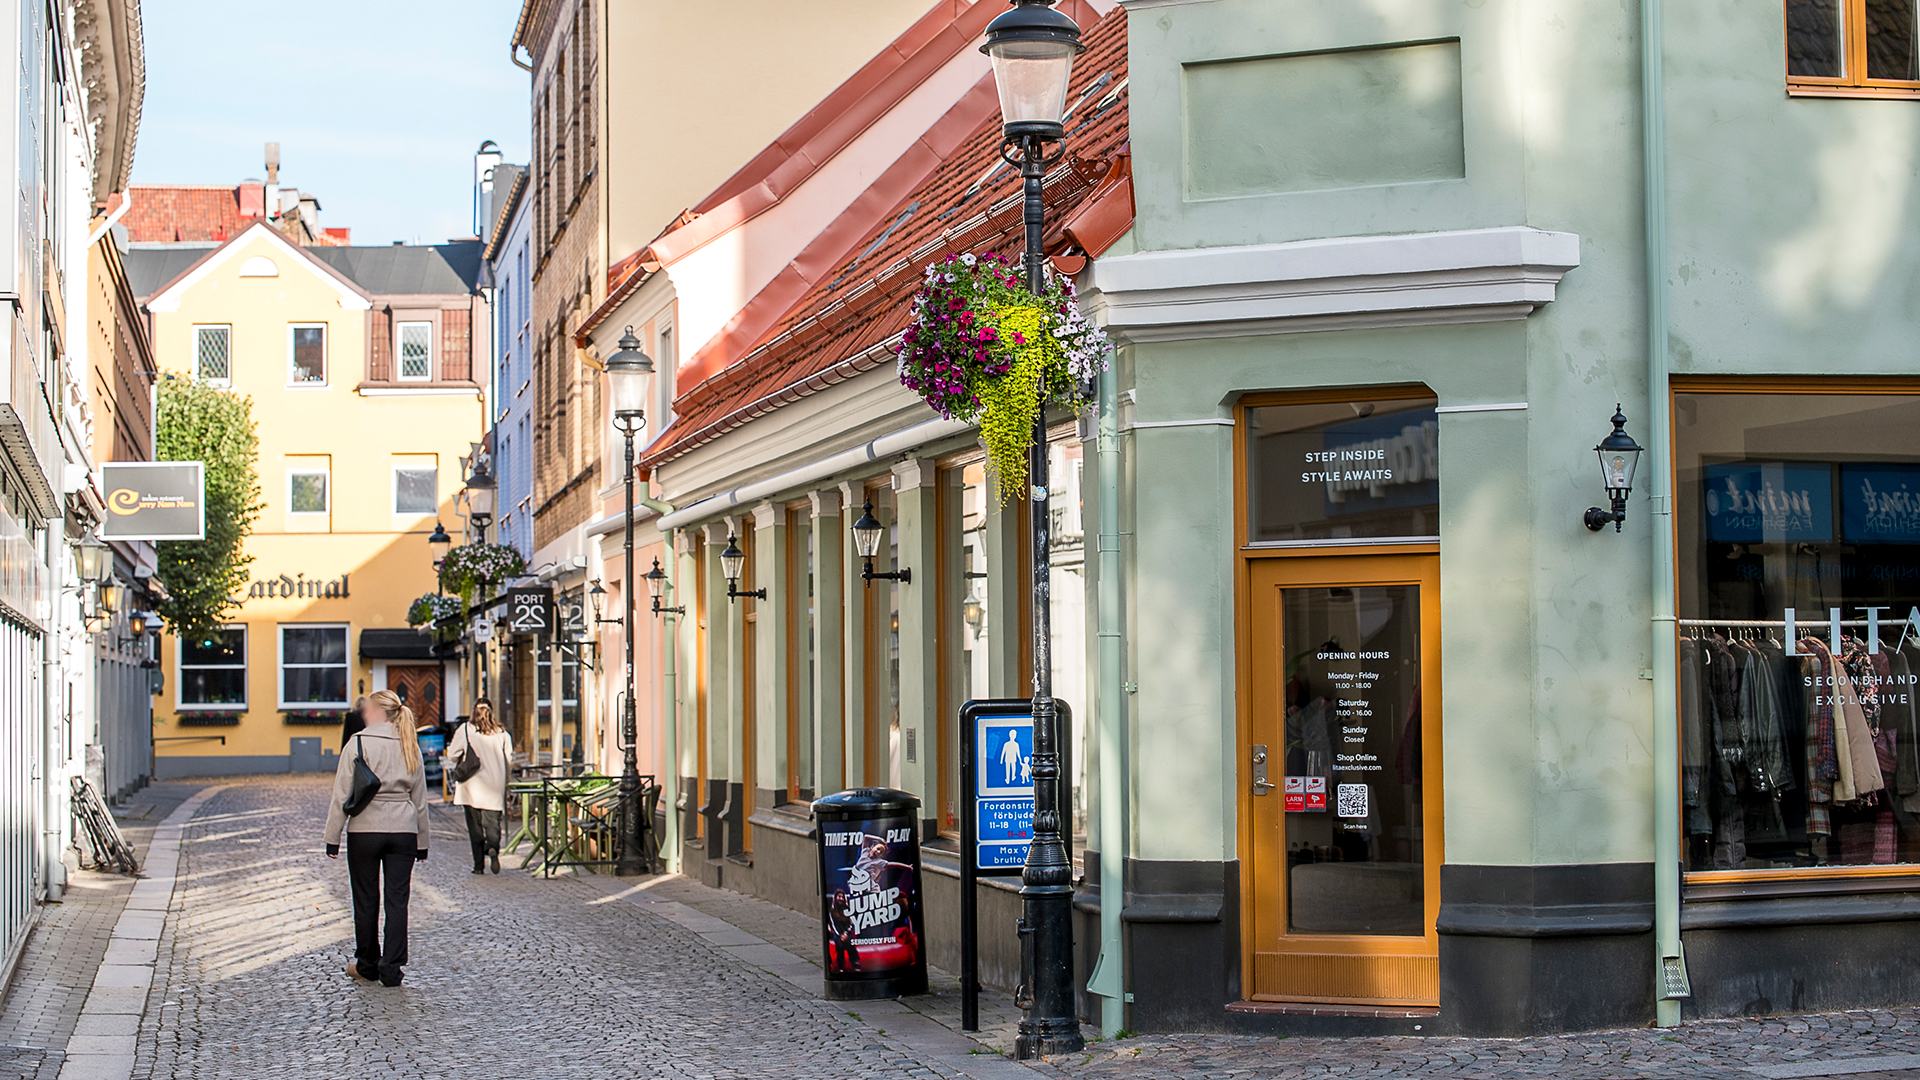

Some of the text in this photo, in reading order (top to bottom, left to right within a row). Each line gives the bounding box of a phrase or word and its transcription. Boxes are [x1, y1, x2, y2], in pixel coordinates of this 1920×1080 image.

[1305, 449, 1385, 463] STEP INSIDE
[1301, 469, 1392, 483] STYLE AWAITS
[514, 594, 546, 604] PORT
[1784, 605, 1920, 657] LITA
[1316, 651, 1390, 660] OPENING HOURS
[1327, 672, 1354, 681] Monday
[1358, 671, 1380, 681] Friday
[1803, 674, 1918, 687] SECONDHAND
[1338, 699, 1369, 708] Saturday
[1815, 694, 1908, 706] EXCLUSIVE
[1355, 709, 1373, 717] 16.00
[1342, 726, 1368, 735] Sunday
[1343, 735, 1365, 743] Closed
[1336, 753, 1377, 762] Shop Online
[989, 821, 1009, 829] 11-18
[824, 828, 911, 846] TIME TO PLAY
[1007, 830, 1027, 838] 11-18
[1000, 846, 1019, 854] Max
[843, 886, 901, 917] JUMP
[850, 903, 902, 936] YARD
[850, 936, 897, 946] SERIOUSLY FUN
